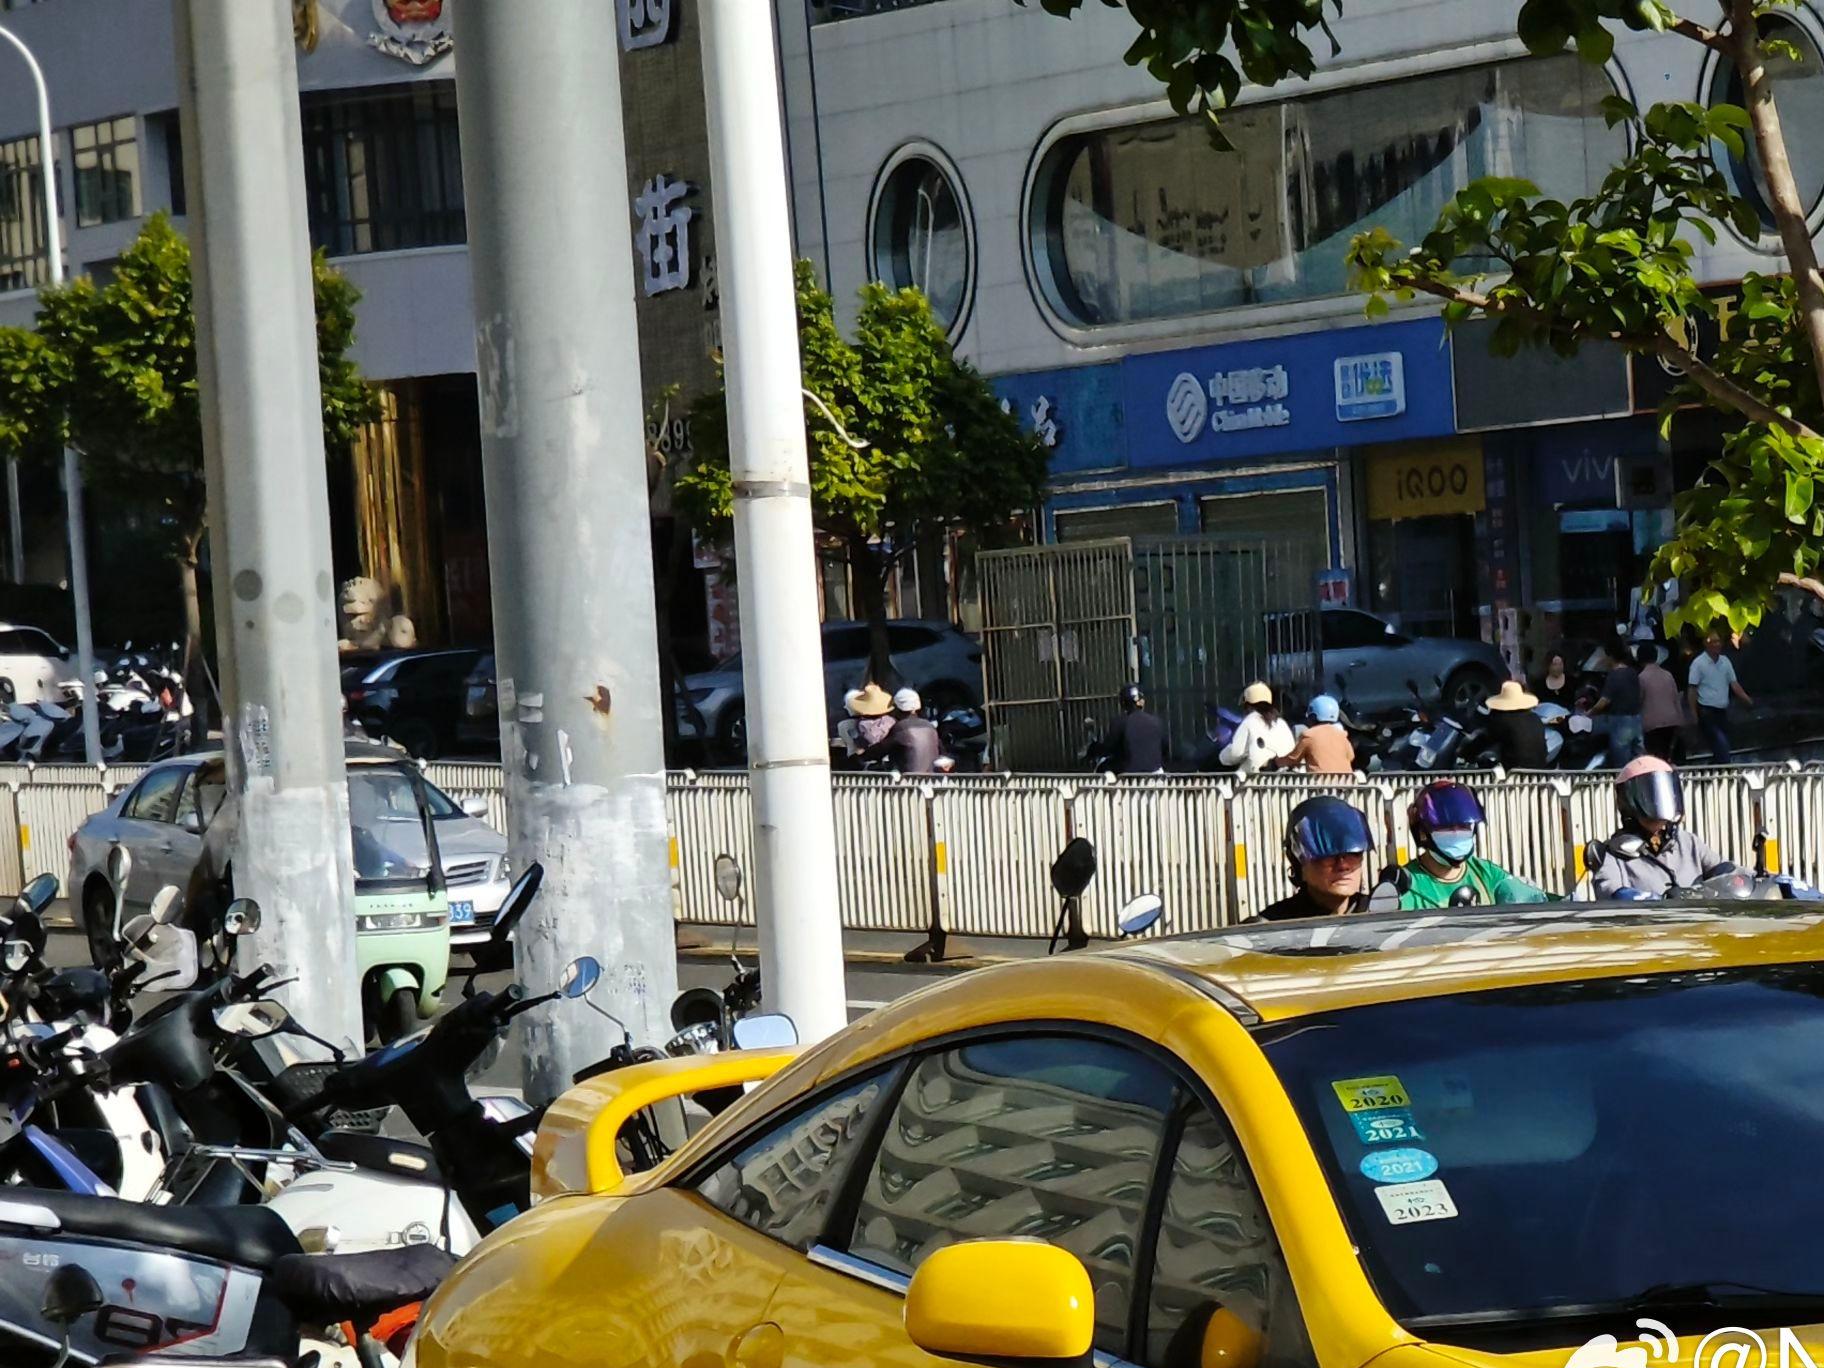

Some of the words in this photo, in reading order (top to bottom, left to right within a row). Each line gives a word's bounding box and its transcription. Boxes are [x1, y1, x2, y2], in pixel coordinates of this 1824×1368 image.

[1561, 447, 1613, 483] viv
[1396, 462, 1468, 500] iQOO
[1350, 1094, 1404, 1109] 2020
[1365, 1126, 1420, 1142] 2021
[1380, 1161, 1424, 1177] 2021
[1394, 1202, 1449, 1221] 2023
